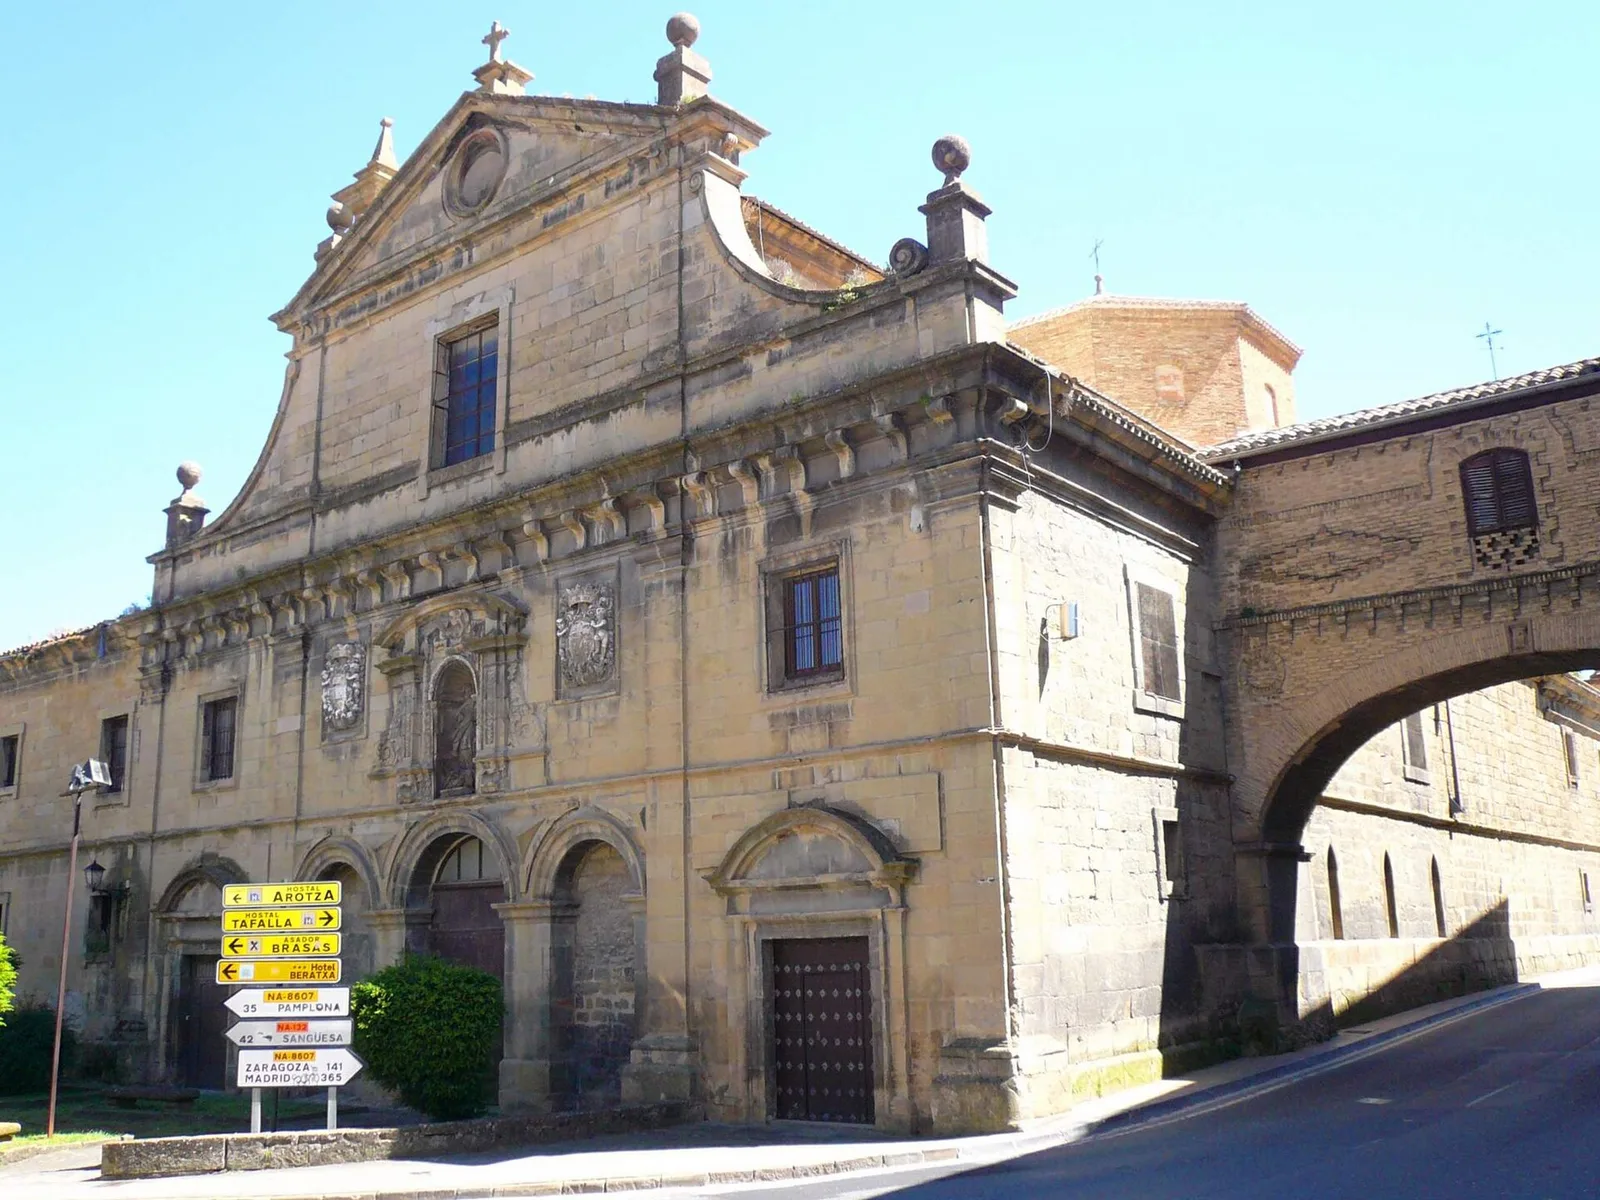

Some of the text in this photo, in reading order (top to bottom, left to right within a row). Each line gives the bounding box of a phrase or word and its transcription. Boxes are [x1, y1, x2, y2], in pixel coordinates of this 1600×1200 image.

[273, 890, 334, 902] AROTZA
[232, 918, 292, 928] TAFALLA
[272, 943, 331, 953] BRASAS
[290, 970, 336, 979] BERATXA
[268, 992, 314, 1001] NA-8607
[243, 1003, 340, 1013] 35 PAMPLONA
[239, 1032, 344, 1044] 42 SANGÜESA
[274, 1052, 315, 1061] NA-8607
[246, 1063, 310, 1072] ZARAGOZA
[245, 1074, 290, 1083] MADRID
[321, 1073, 342, 1082] 365
